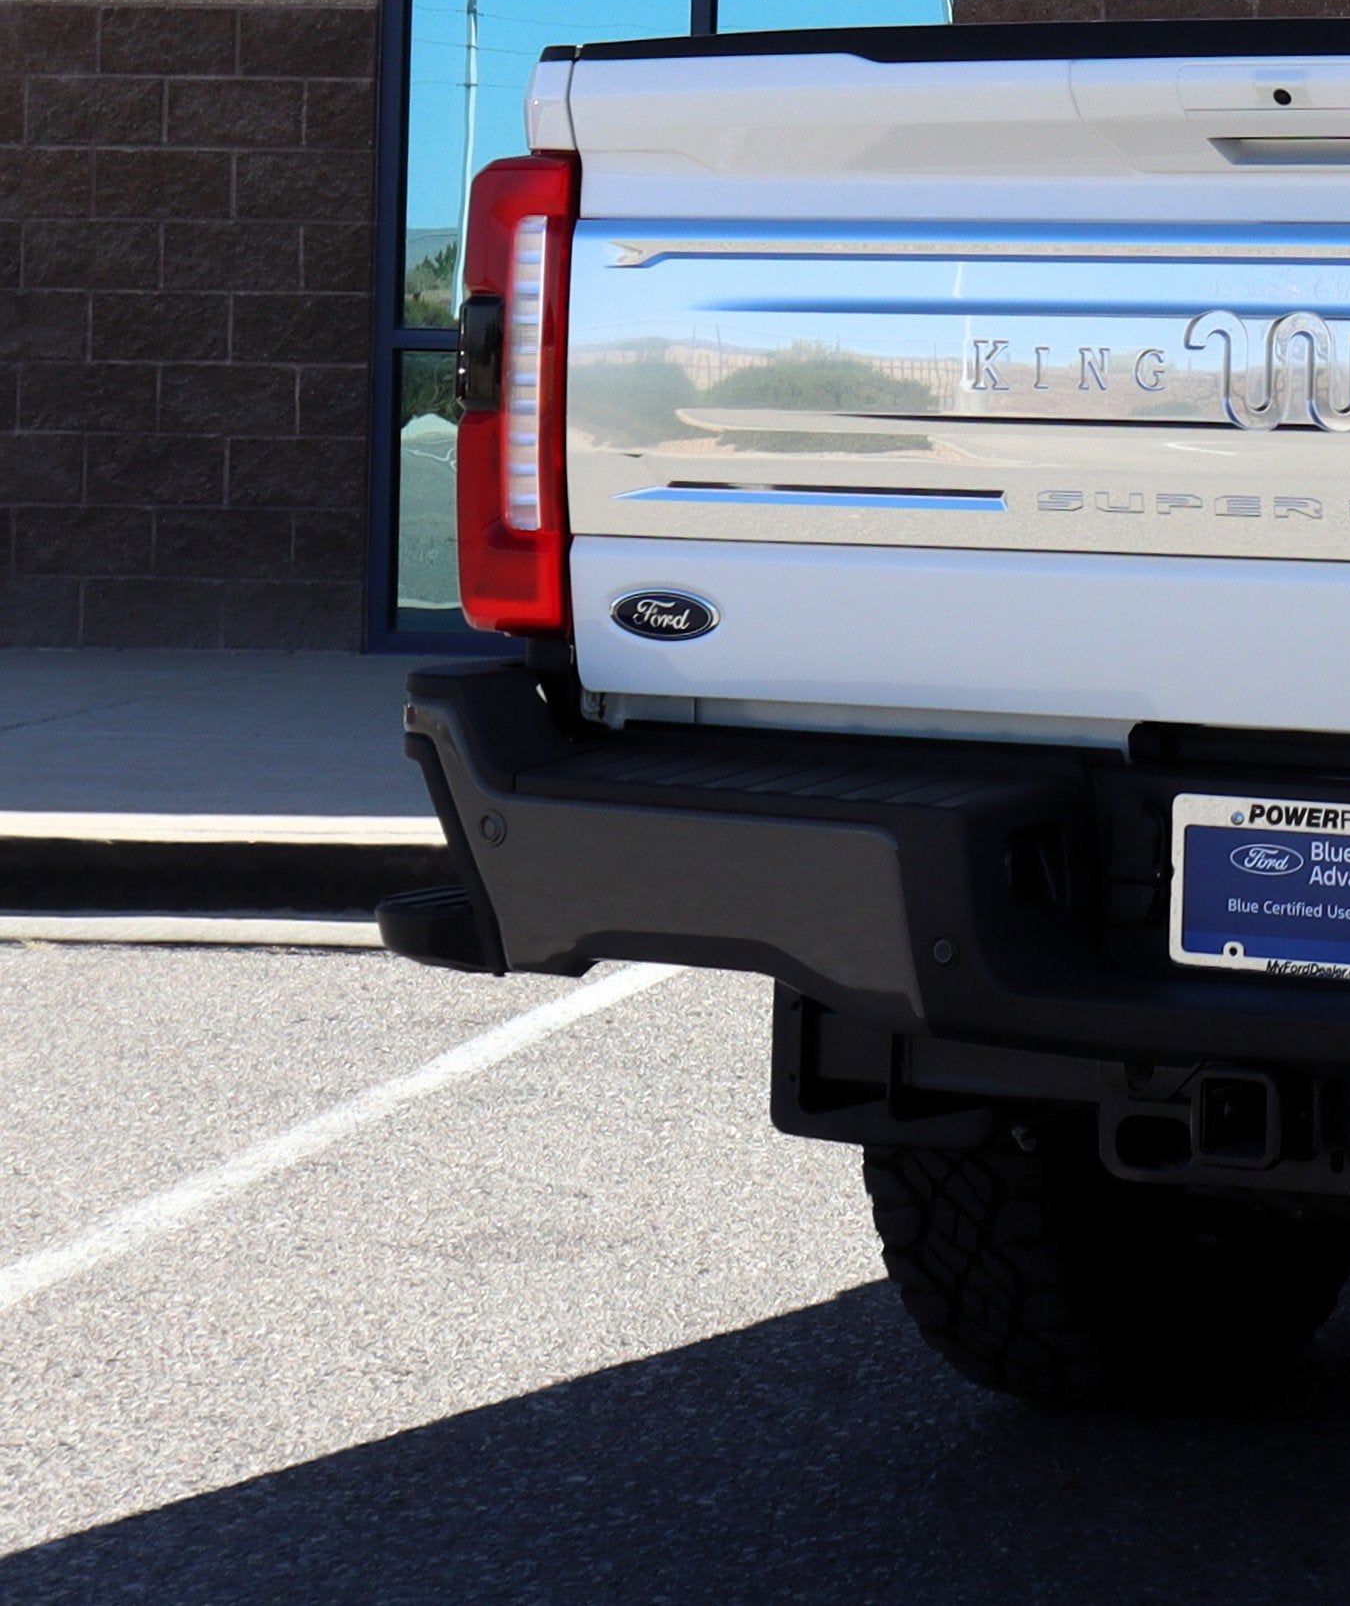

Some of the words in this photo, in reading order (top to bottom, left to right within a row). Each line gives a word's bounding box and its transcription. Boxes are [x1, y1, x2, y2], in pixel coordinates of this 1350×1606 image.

[972, 339, 1166, 392] KING
[1036, 489, 1324, 521] SUPER
[632, 598, 691, 630] Ford
[1243, 846, 1290, 872] Ford
[1227, 897, 1260, 914] Blue
[1262, 900, 1324, 918] Certified
